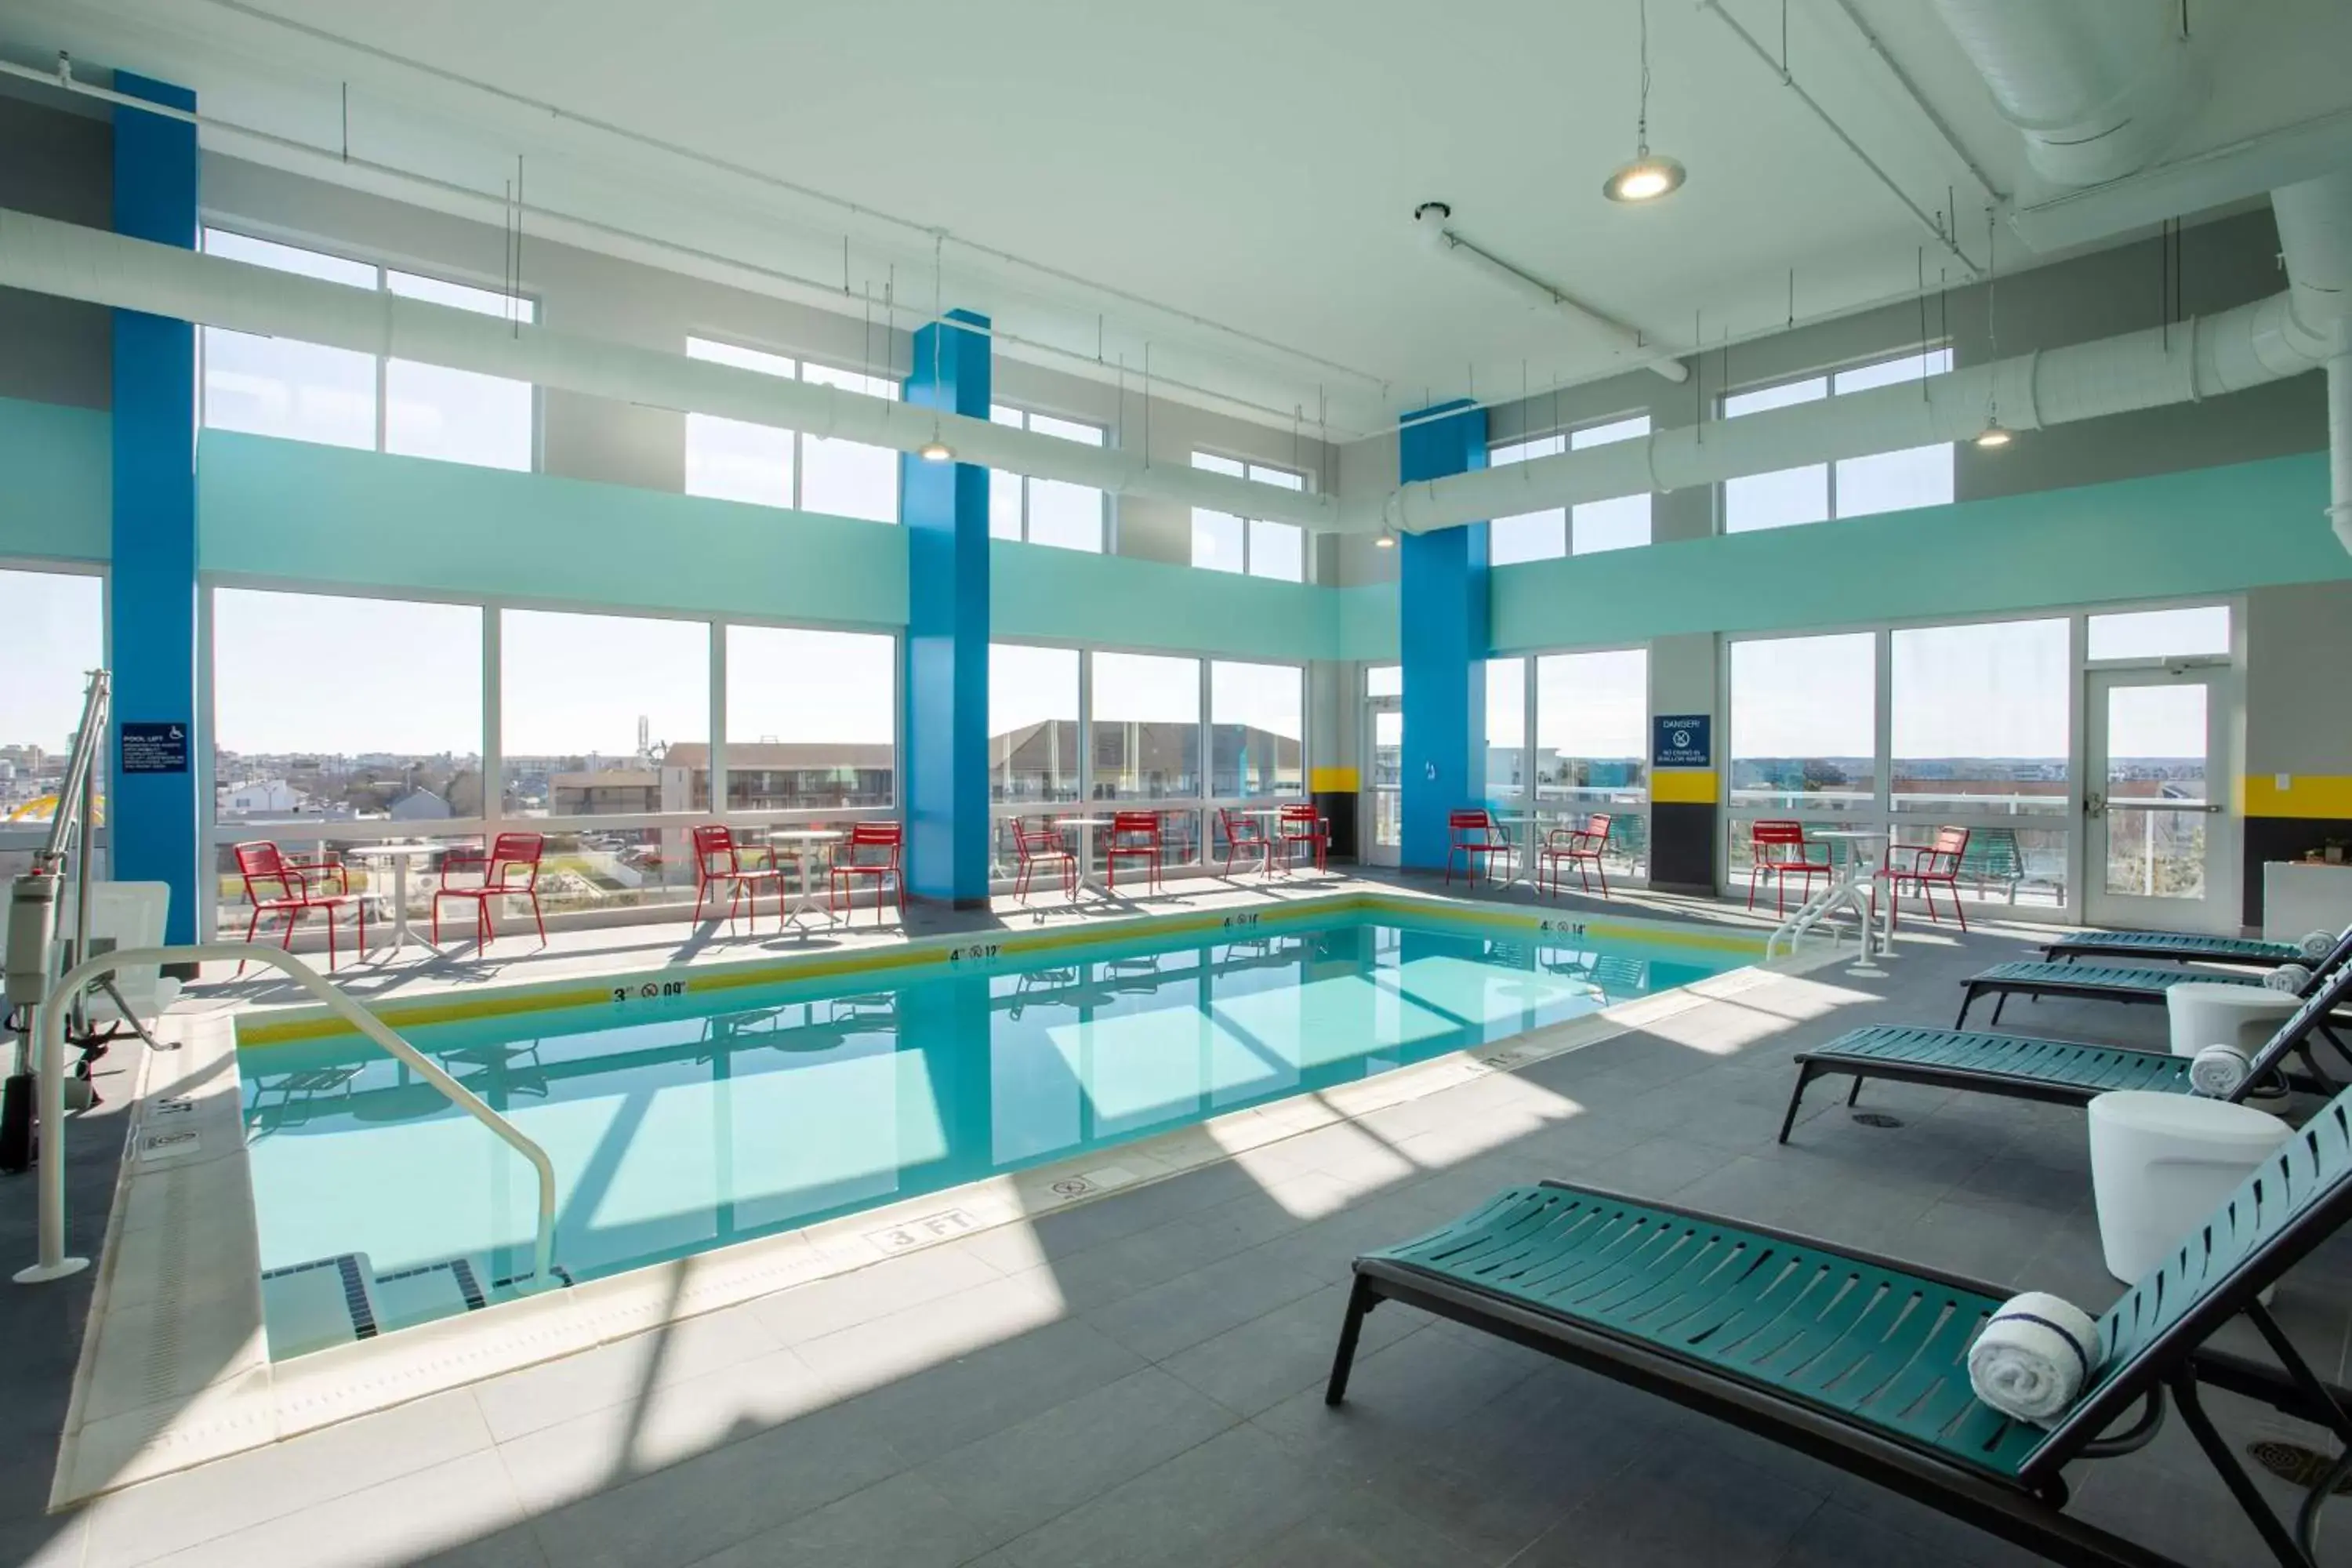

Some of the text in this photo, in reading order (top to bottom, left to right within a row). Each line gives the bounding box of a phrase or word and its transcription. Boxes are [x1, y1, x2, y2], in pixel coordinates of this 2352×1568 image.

[1663, 720, 1700, 728] DANGER!
[888, 1213, 971, 1246] 3 FT
